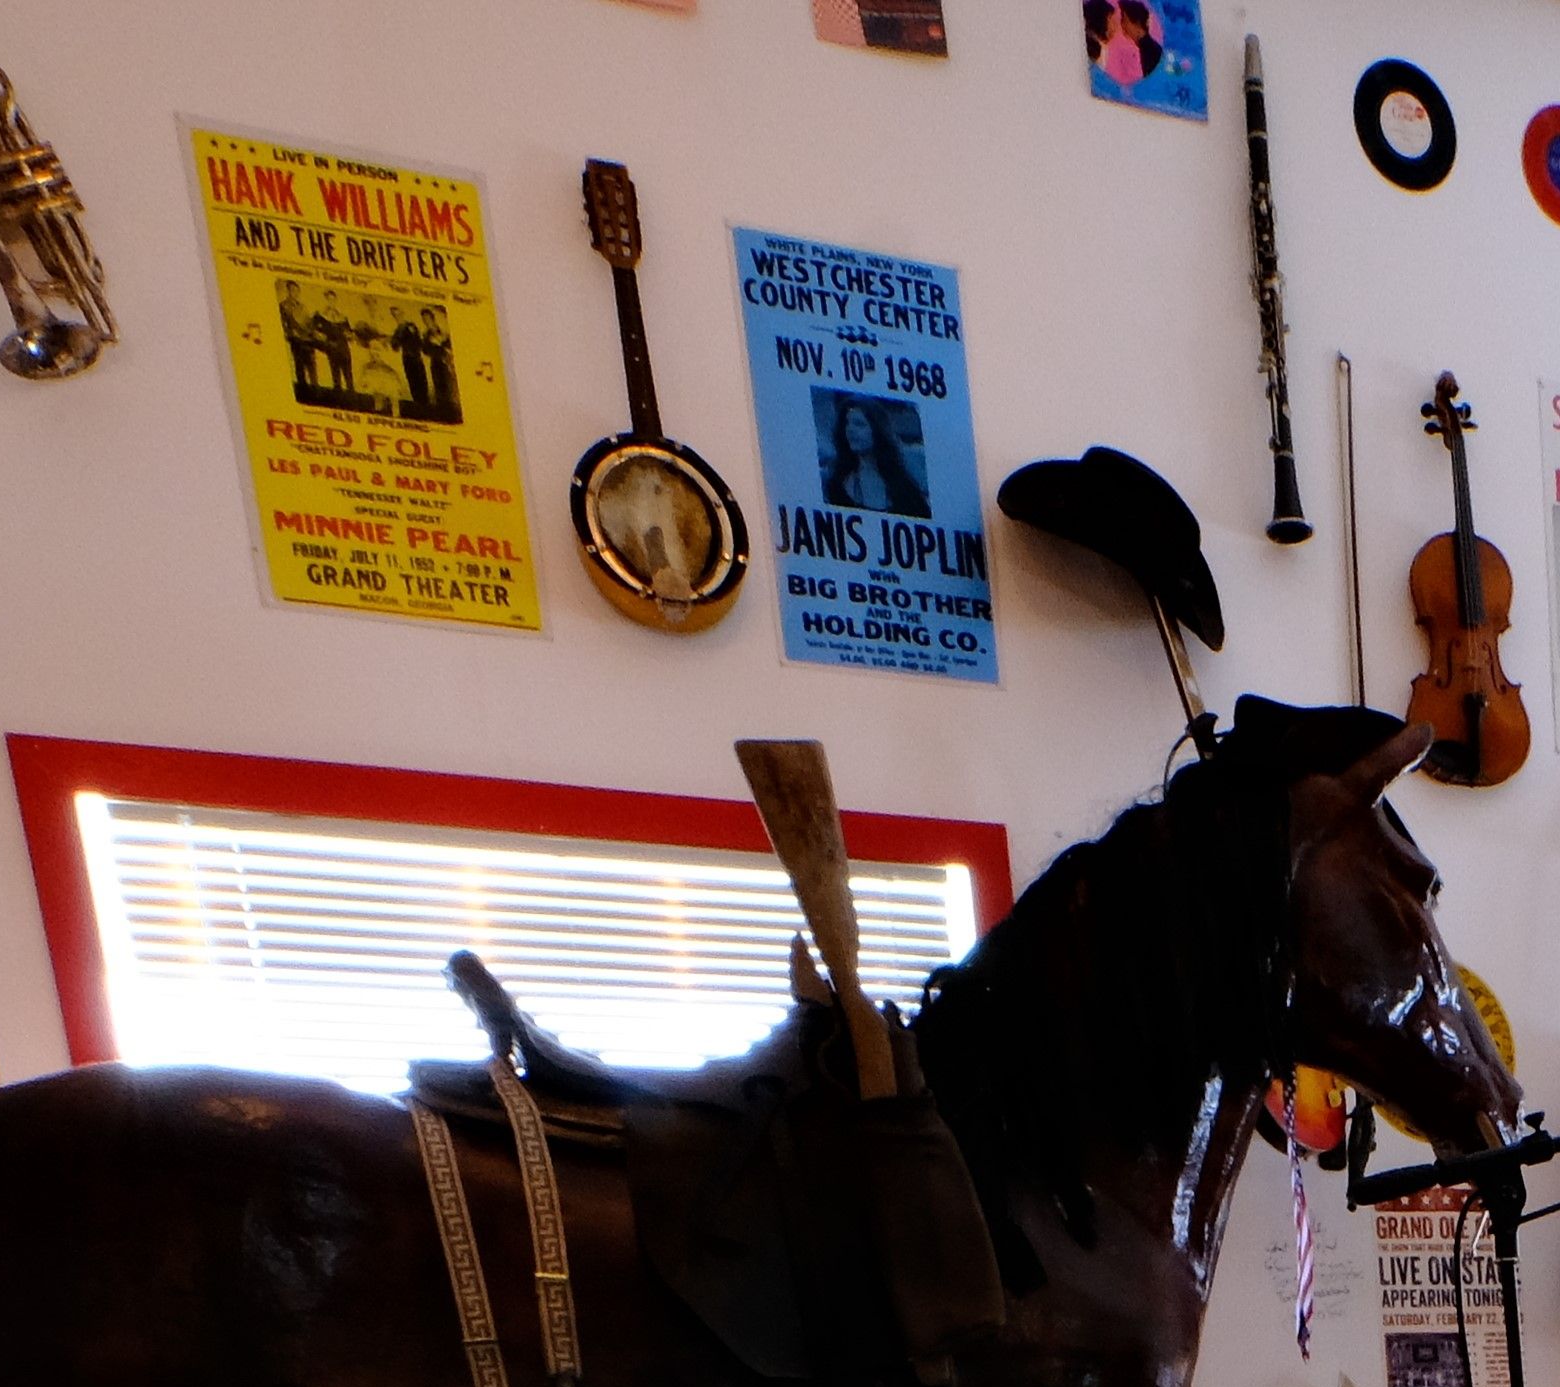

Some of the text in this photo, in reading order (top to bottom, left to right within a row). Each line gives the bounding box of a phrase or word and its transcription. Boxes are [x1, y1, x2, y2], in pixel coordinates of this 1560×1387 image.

[273, 148, 399, 182] LIVE PERSON
[207, 156, 474, 247] HANK WILLIAMS
[236, 216, 280, 251] AND
[290, 226, 340, 263] THE
[346, 236, 470, 285] DRIFTER'S
[764, 237, 805, 254] WHITE
[899, 262, 933, 279] YORK
[750, 248, 946, 310] WESTCHESTER
[744, 277, 960, 341] COUNTY CENTER
[776, 335, 833, 378] NOV.
[885, 354, 946, 399] 1968
[266, 419, 353, 448] RED
[367, 434, 497, 470] FOLEY
[268, 457, 512, 504] LES PAUL MARY FORD
[274, 510, 522, 562] MINNIE PEARL
[777, 504, 987, 581] JANIS JOPLIN
[307, 564, 511, 607] GRAND THEATER
[788, 574, 993, 621] BIG BROTHER
[803, 611, 988, 654] HOLDING CO.
[866, 607, 892, 620] AND
[1377, 1217, 1433, 1239] GRAND
[1379, 1256, 1455, 1285] LIVE ON
